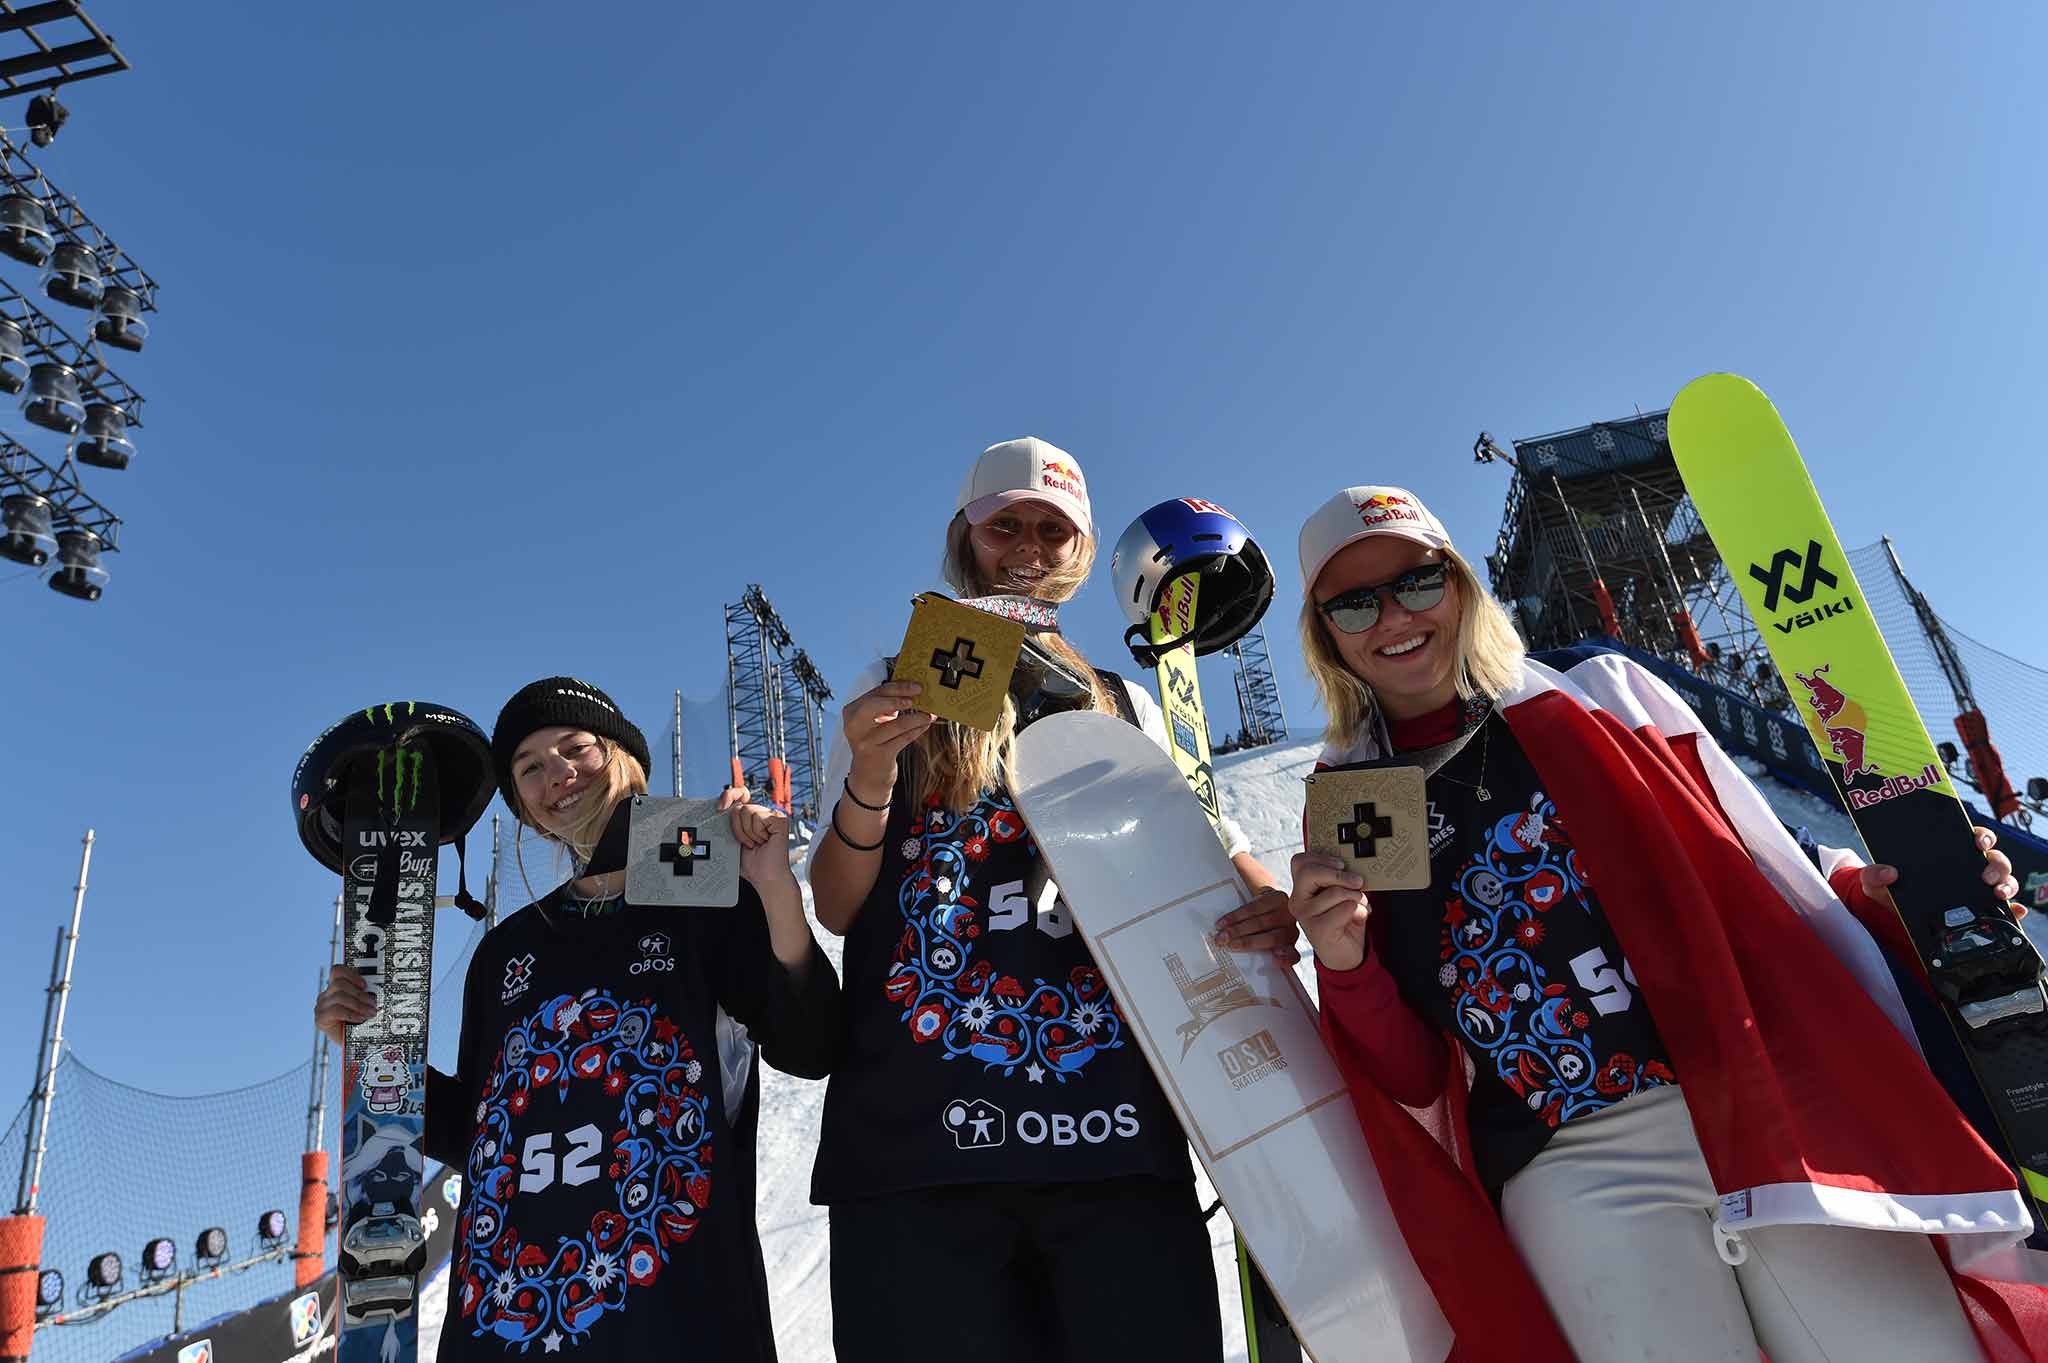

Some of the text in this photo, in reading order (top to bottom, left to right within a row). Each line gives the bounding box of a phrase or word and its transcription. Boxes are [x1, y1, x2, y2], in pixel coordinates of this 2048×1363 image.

[1043, 475, 1067, 491] Red
[1363, 508, 1420, 527] Red Bull
[1176, 575, 1196, 617] Bull
[1773, 596, 1854, 634] völkl
[1847, 763, 1942, 811] Red Bull
[360, 831, 427, 847] uvex
[400, 851, 433, 877] Buff
[988, 878, 1074, 939] 56
[389, 881, 425, 1036] SAMSUNG
[629, 957, 676, 976] OBOS
[1231, 1055, 1289, 1091] SKATEBOARDS
[1016, 1103, 1141, 1146] OBOS
[518, 1122, 603, 1194] 52
